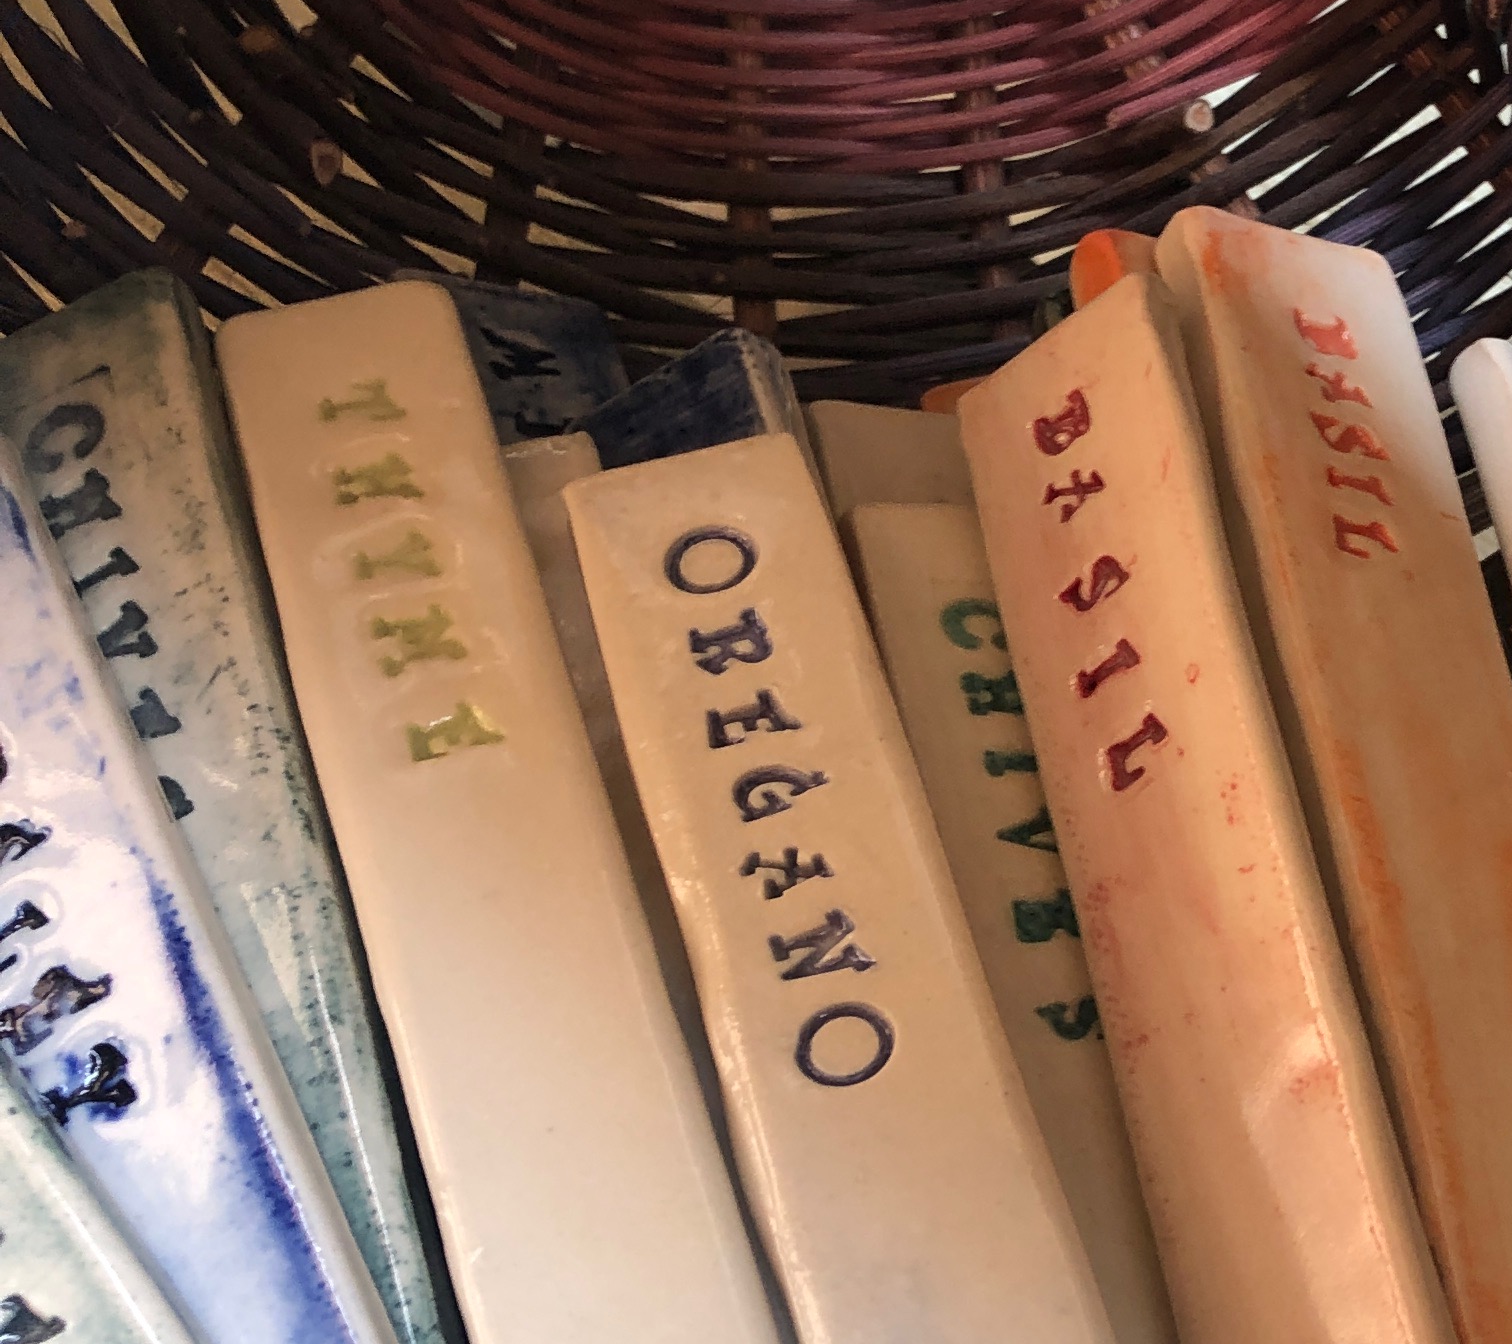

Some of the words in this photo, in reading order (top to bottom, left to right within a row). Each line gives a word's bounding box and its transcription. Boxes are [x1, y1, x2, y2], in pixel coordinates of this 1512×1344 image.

[319, 378, 505, 763] THYME
[1032, 389, 1170, 793] BASIL
[1292, 308, 1400, 560] BASIL
[664, 525, 896, 1087] OREGANO
